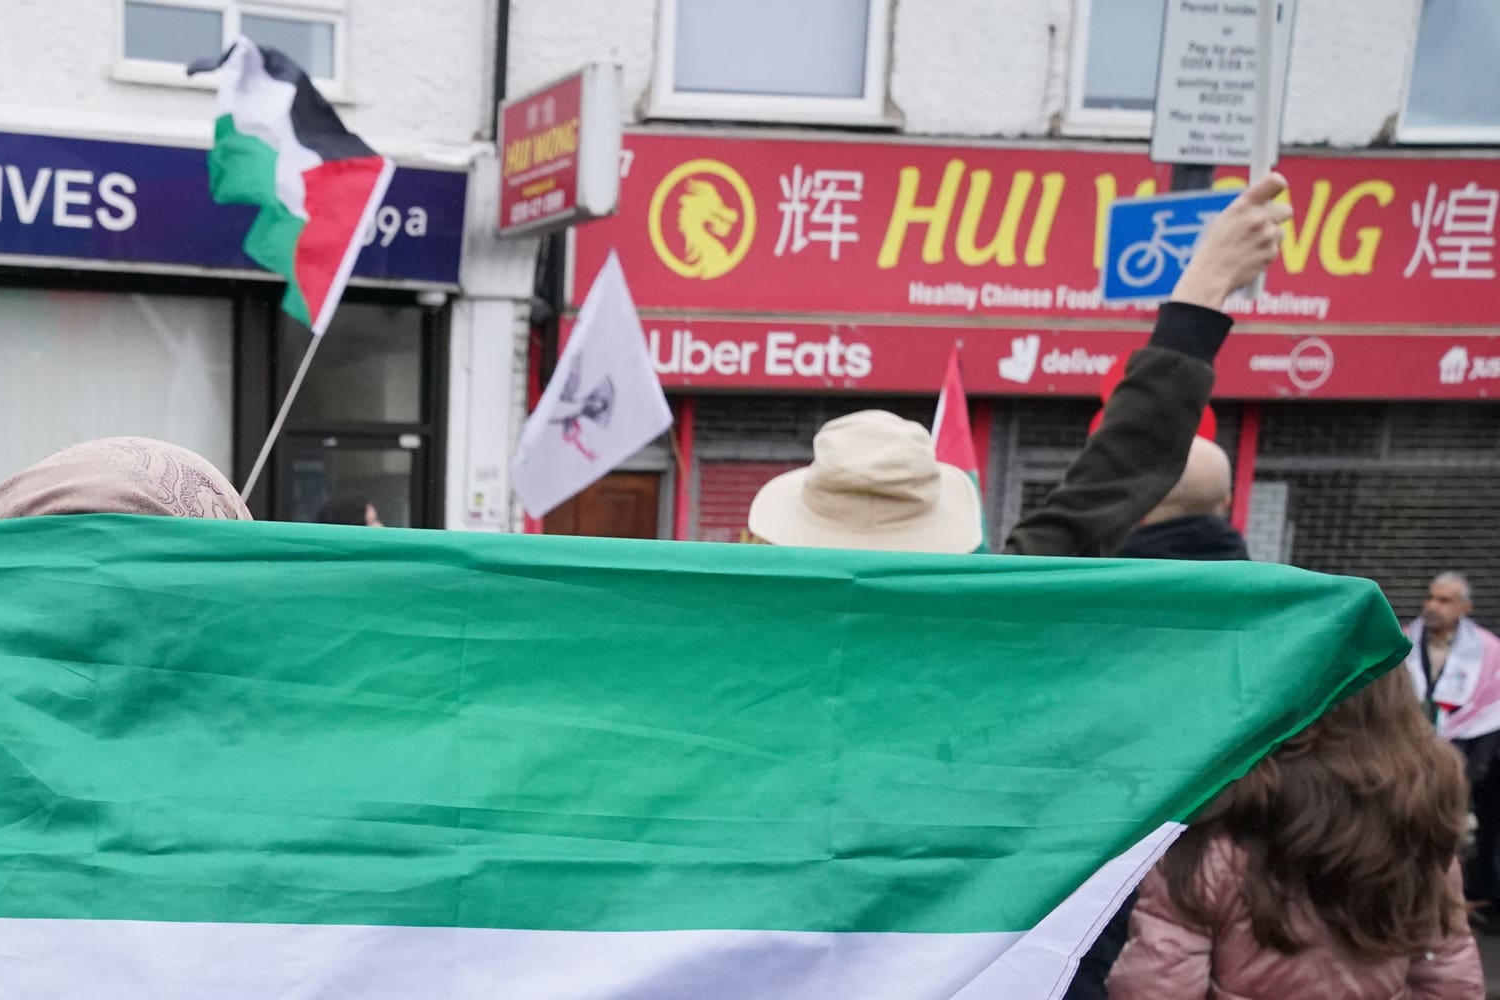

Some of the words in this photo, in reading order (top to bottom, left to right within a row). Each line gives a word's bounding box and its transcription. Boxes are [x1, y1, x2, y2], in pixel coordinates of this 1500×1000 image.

[1223, 4, 1257, 15] holde
[1229, 46, 1255, 56] phon
[774, 163, 864, 262] 辉
[877, 158, 1066, 269] HUI
[1094, 172, 1395, 277] NG
[1403, 182, 1499, 280] 煌
[909, 282, 977, 311] Healthy
[981, 282, 1052, 308] Chinese
[650, 330, 758, 374] Uber
[764, 331, 873, 377] Eats
[1041, 347, 1118, 375] delive
